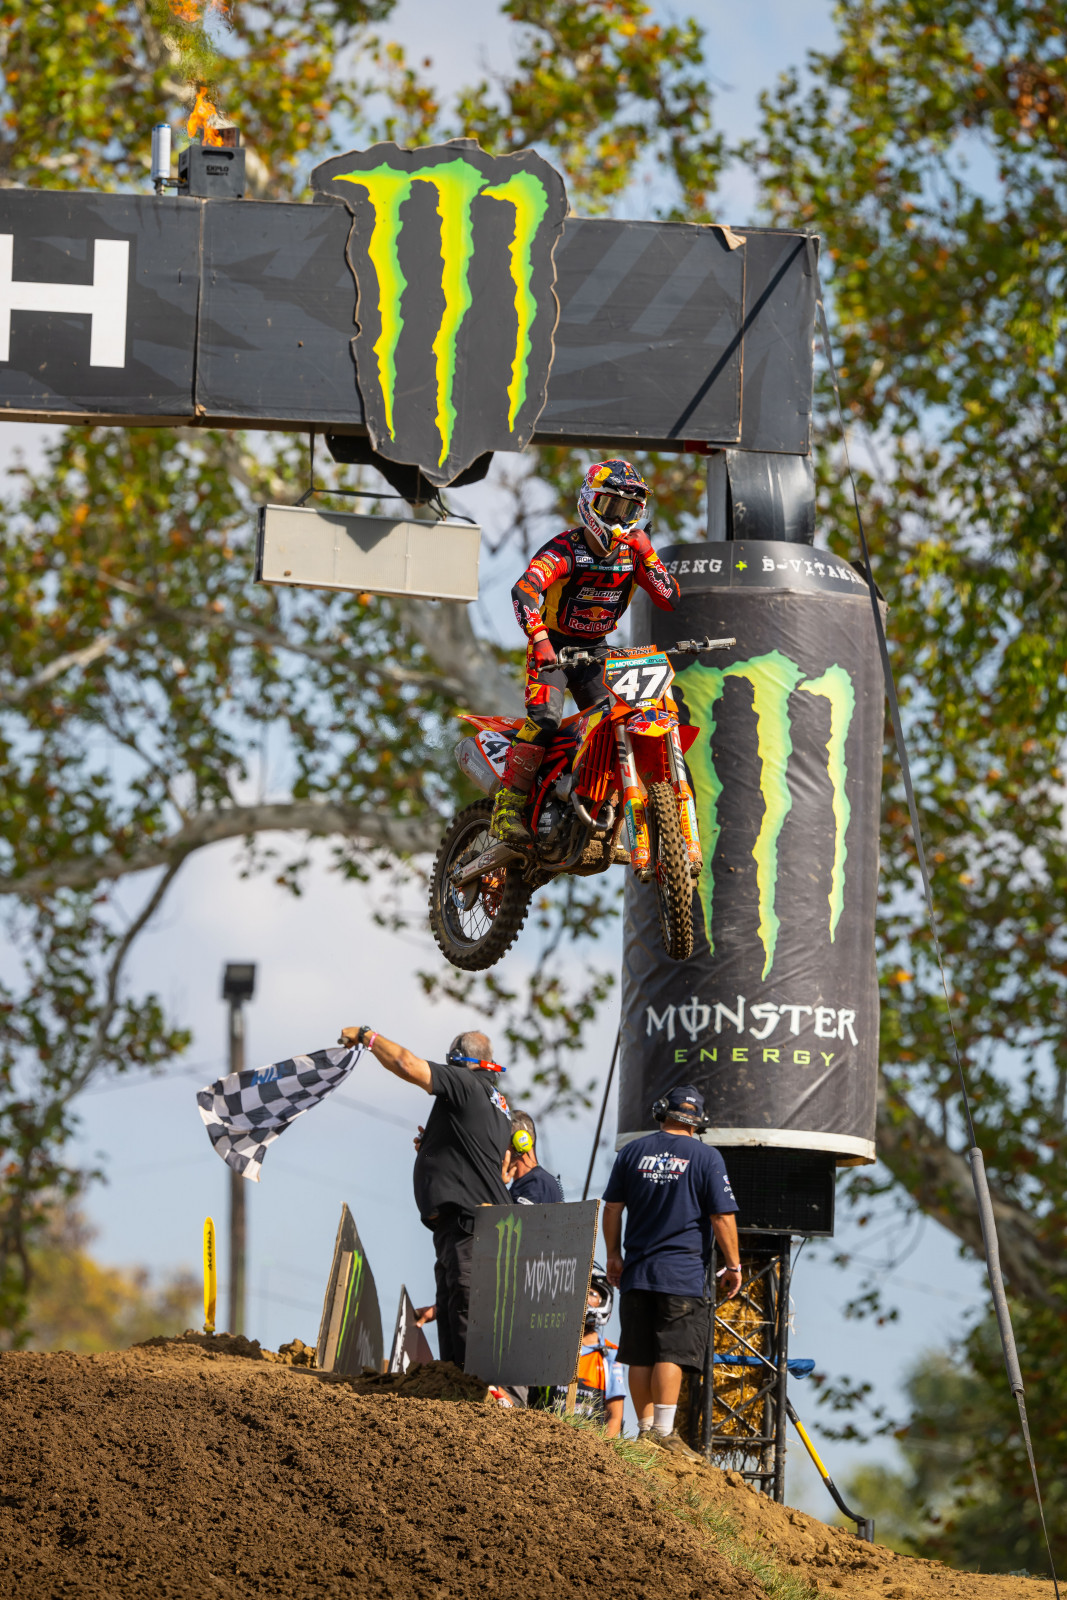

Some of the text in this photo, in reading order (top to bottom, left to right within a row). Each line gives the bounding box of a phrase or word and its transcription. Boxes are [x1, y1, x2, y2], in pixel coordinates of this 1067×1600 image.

[664, 559, 723, 574] SENG
[576, 571, 630, 588] FLY
[615, 658, 648, 668] MOTOREX
[612, 665, 667, 701] 47
[645, 994, 859, 1047] MONSTER
[674, 1048, 835, 1067] ENERGY
[642, 1172, 680, 1181] IRONMAN
[524, 1250, 577, 1303] MONSTER
[530, 1312, 567, 1329] ENERGY
